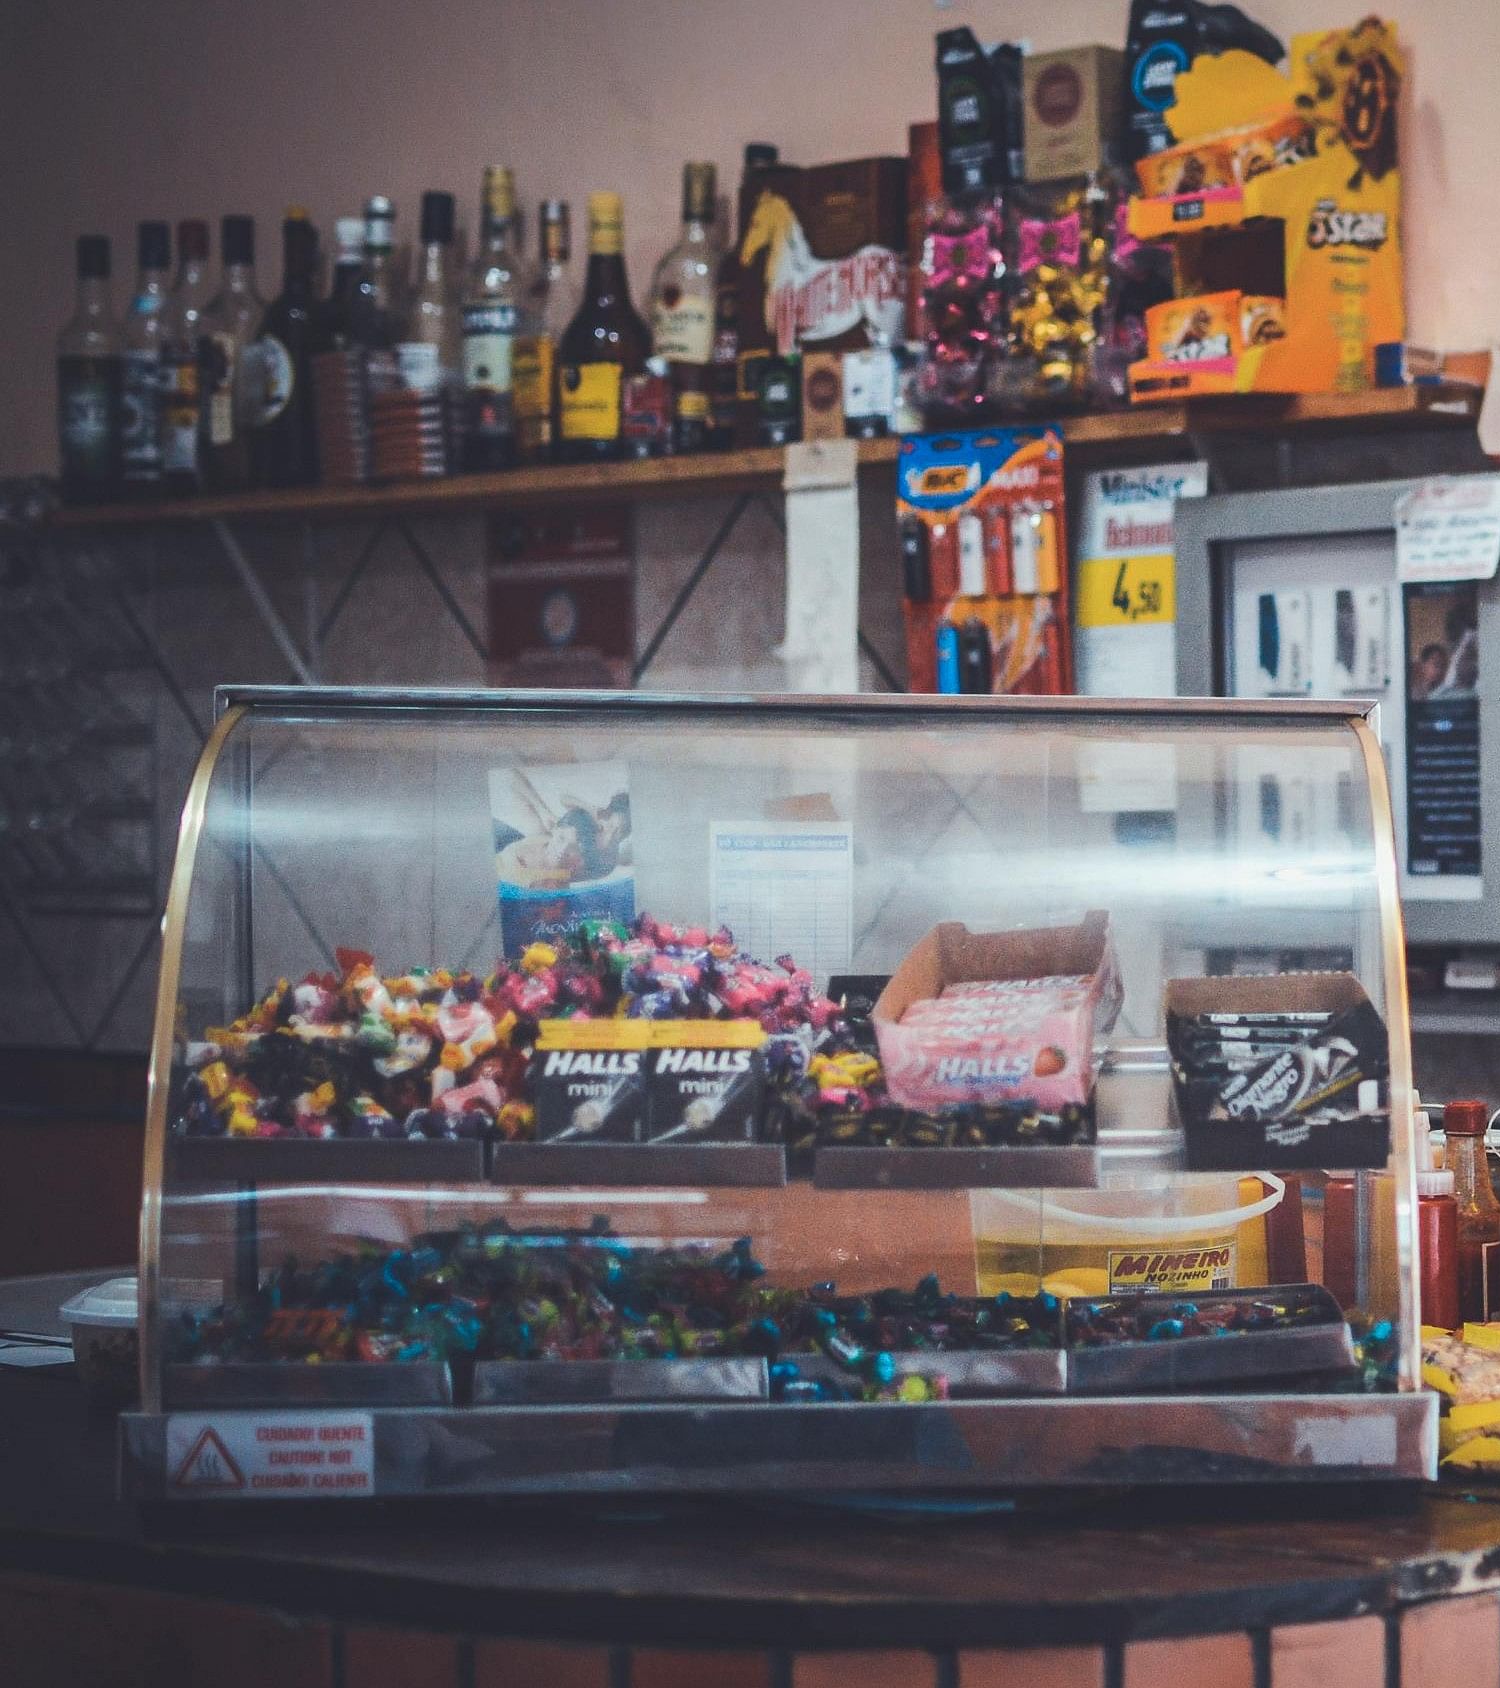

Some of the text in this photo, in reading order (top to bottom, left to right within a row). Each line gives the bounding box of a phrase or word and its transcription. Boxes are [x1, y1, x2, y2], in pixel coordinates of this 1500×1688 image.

[544, 1051, 641, 1077] HALLS
[656, 1049, 752, 1074] HALLS
[935, 1055, 1031, 1083] HALLS
[1114, 1248, 1230, 1277] MINEIRO
[1145, 1269, 1209, 1283] NOZINHO
